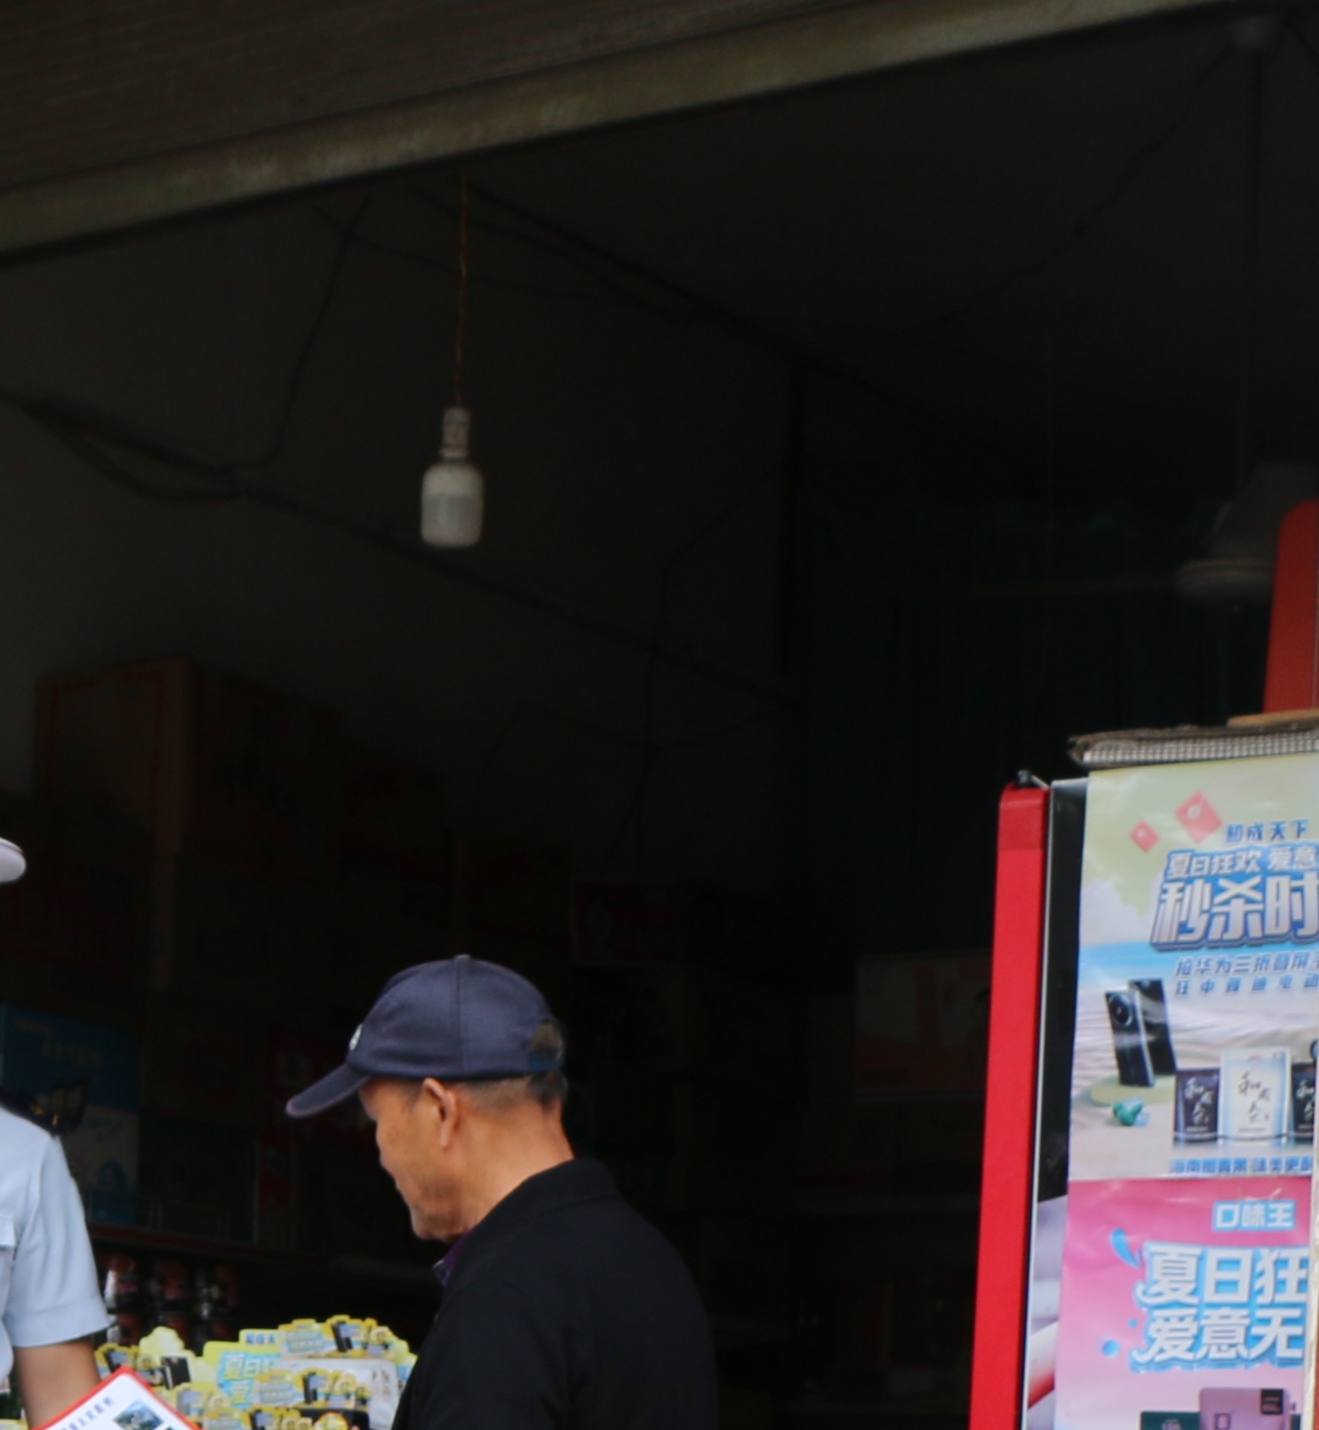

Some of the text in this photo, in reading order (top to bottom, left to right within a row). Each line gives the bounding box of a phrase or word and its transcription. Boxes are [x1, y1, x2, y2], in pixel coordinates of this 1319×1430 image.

[1226, 819, 1309, 843] 和成天下
[1167, 849, 1261, 880] 夏日狂欢
[1214, 1202, 1296, 1230] 口味王
[1136, 1244, 1309, 1306] 夏日狂
[1133, 1307, 1304, 1365] 爱意无
